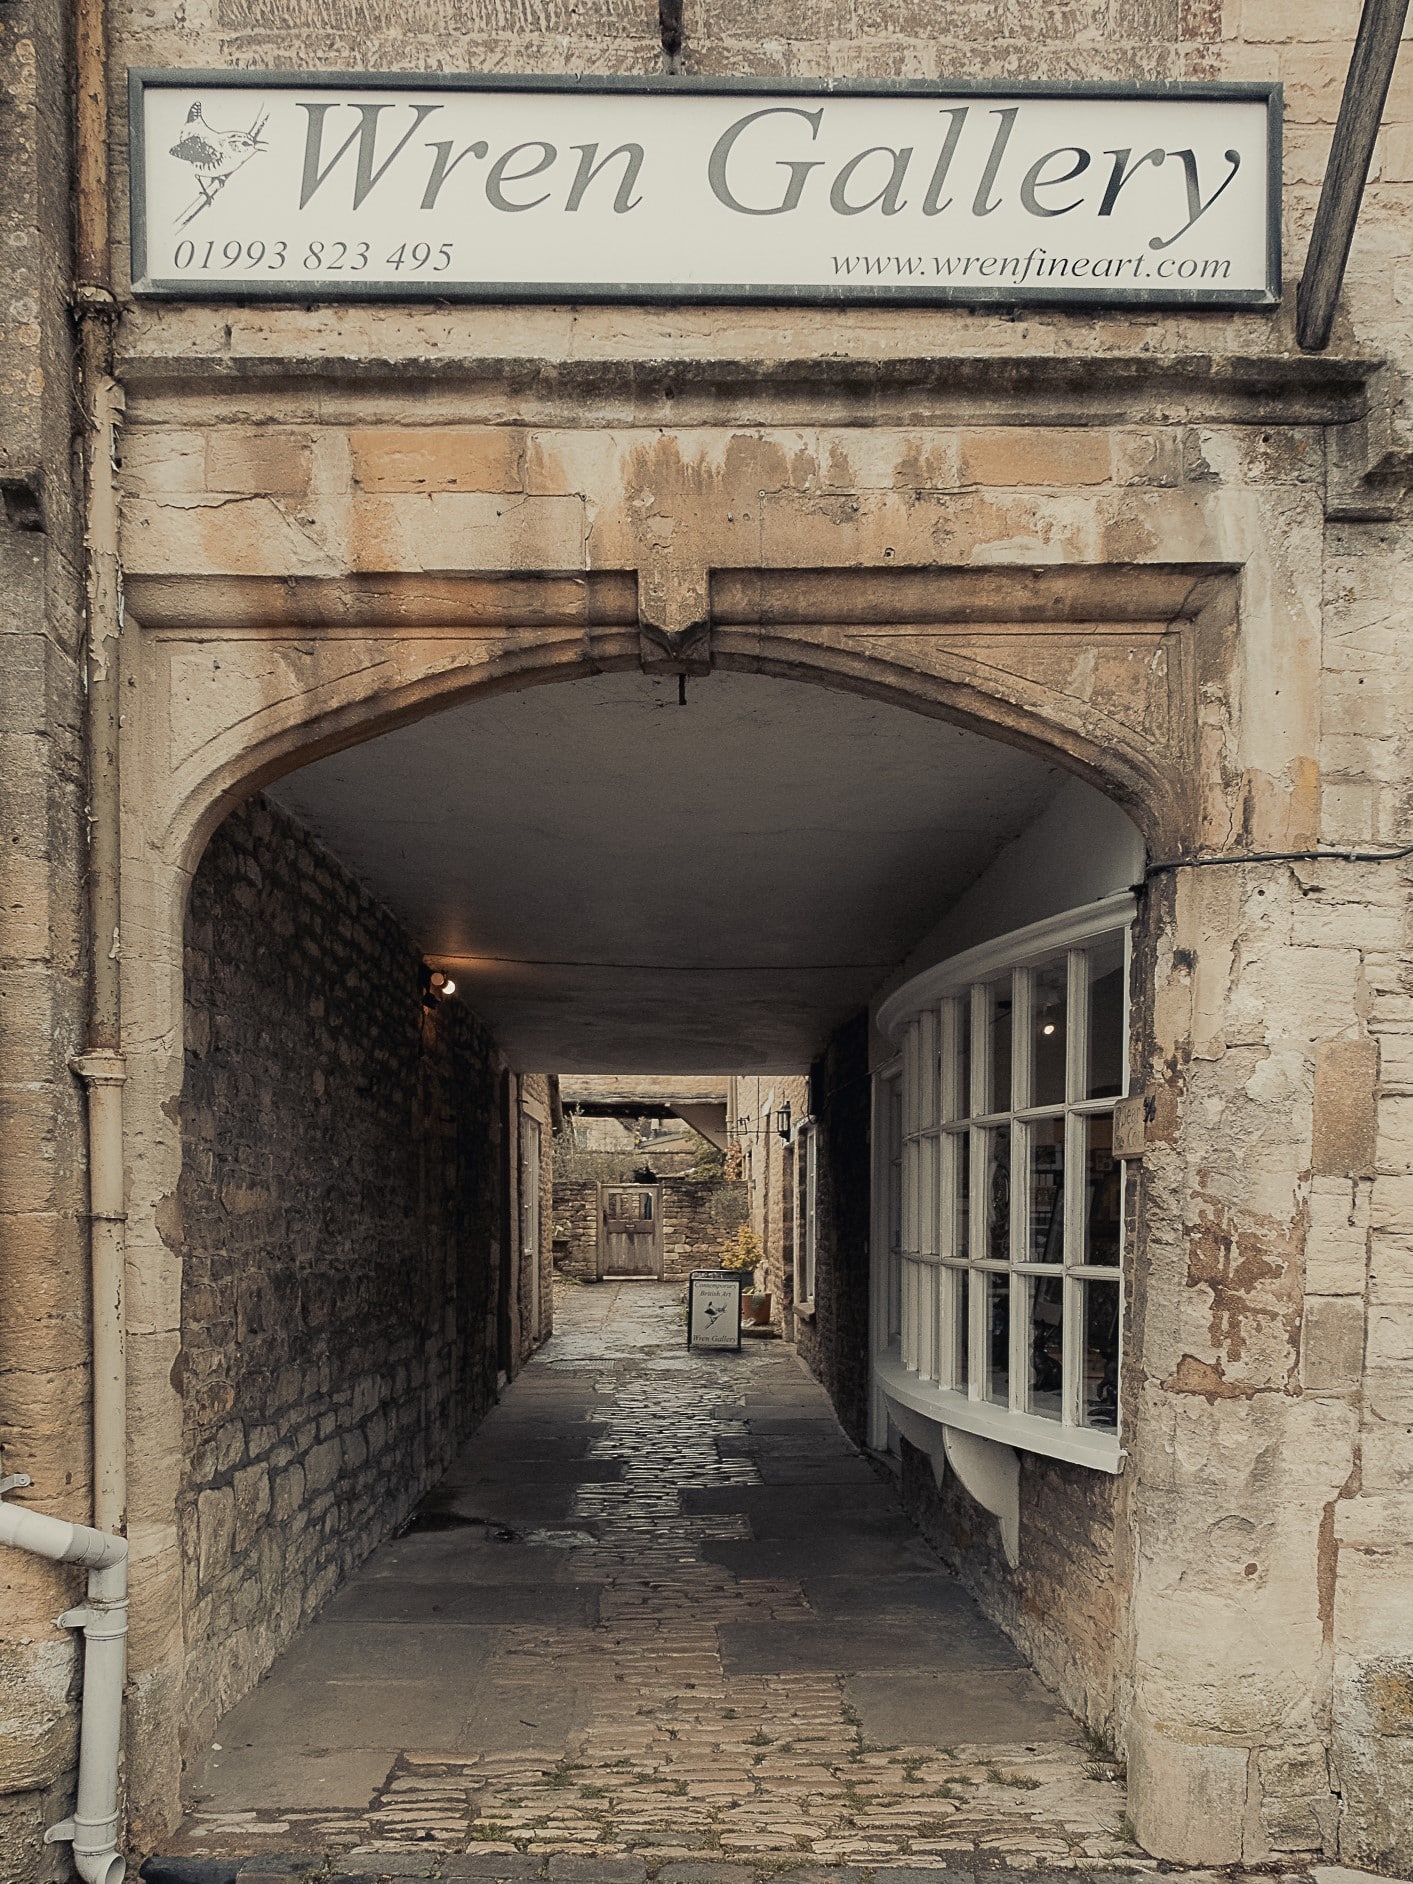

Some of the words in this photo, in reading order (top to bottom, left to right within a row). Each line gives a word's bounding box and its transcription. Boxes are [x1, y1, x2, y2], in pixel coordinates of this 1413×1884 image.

[295, 102, 644, 214] Wren
[706, 105, 1241, 251] Gallery
[174, 240, 288, 270] 01993
[302, 241, 370, 271] 823
[385, 242, 454, 272] 495
[830, 247, 1232, 285] www.wrenfineart.com
[693, 1334, 710, 1342] Wren
[711, 1334, 736, 1344] Gallery
